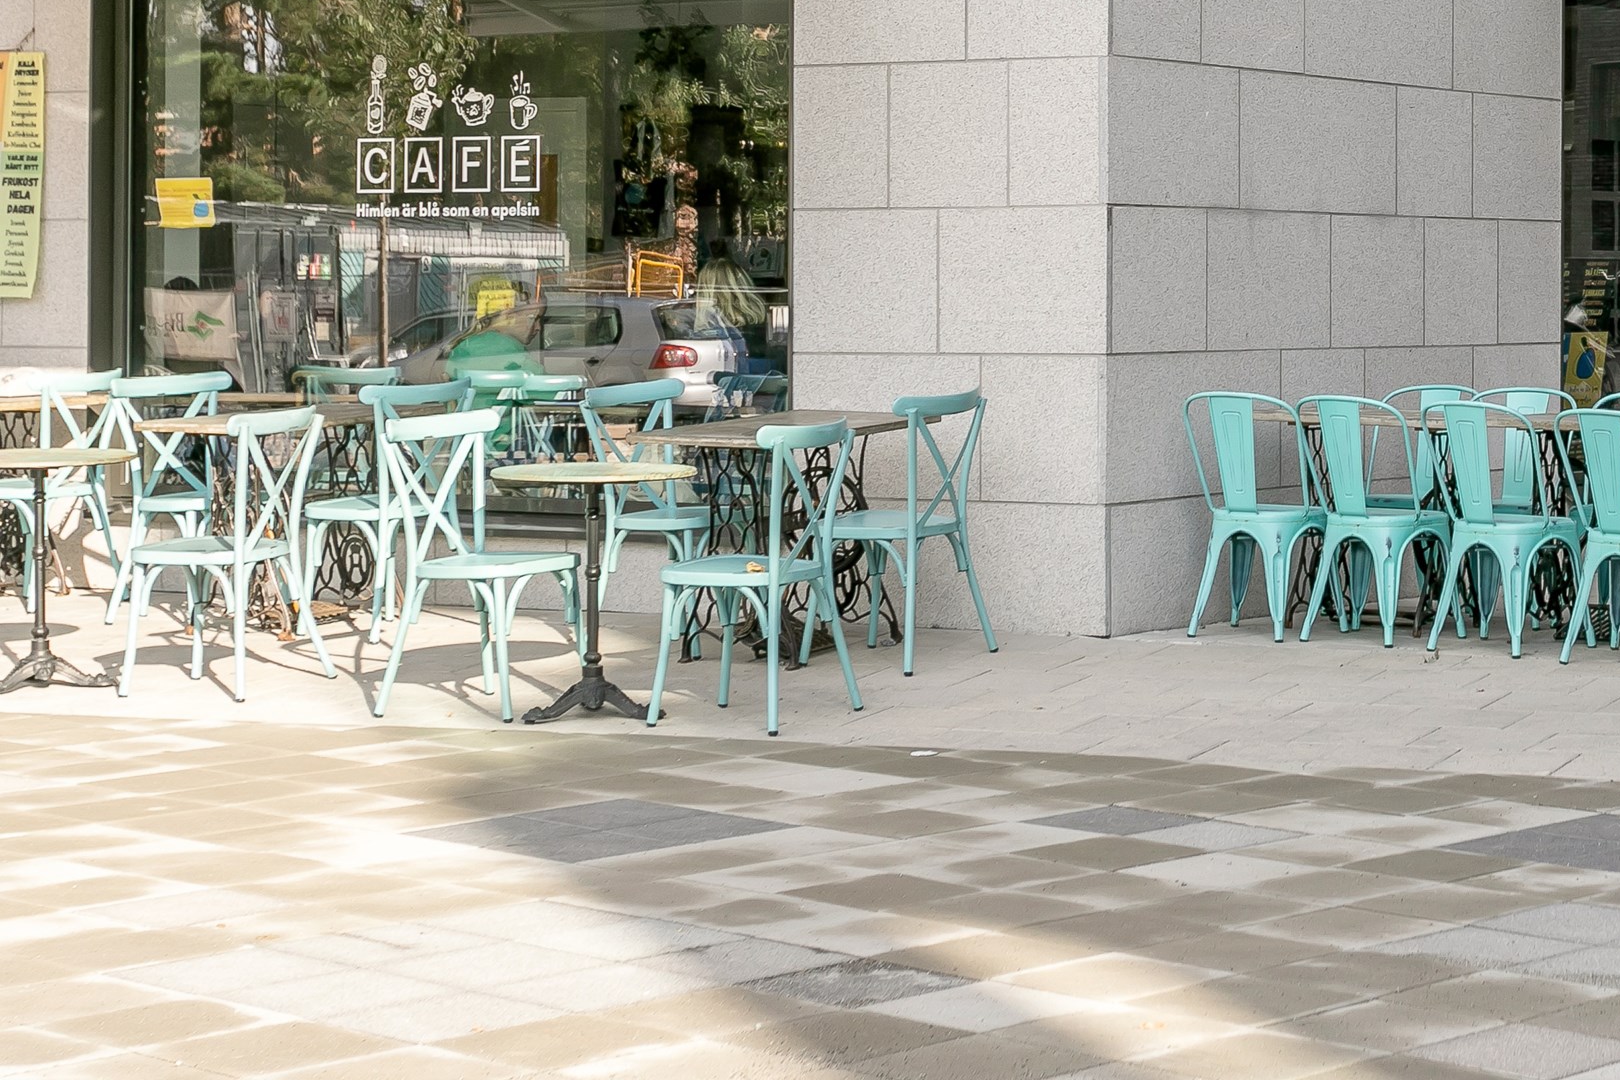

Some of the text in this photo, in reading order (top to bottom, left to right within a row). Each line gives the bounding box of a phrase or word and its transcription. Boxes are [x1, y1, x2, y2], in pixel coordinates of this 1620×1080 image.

[364, 140, 531, 185] CAFÉ
[2, 176, 39, 187] FRUKOST
[9, 190, 31, 200] HELA
[7, 204, 35, 215] DAGEN
[356, 201, 540, 221] Himlen är blå som en apelsin
